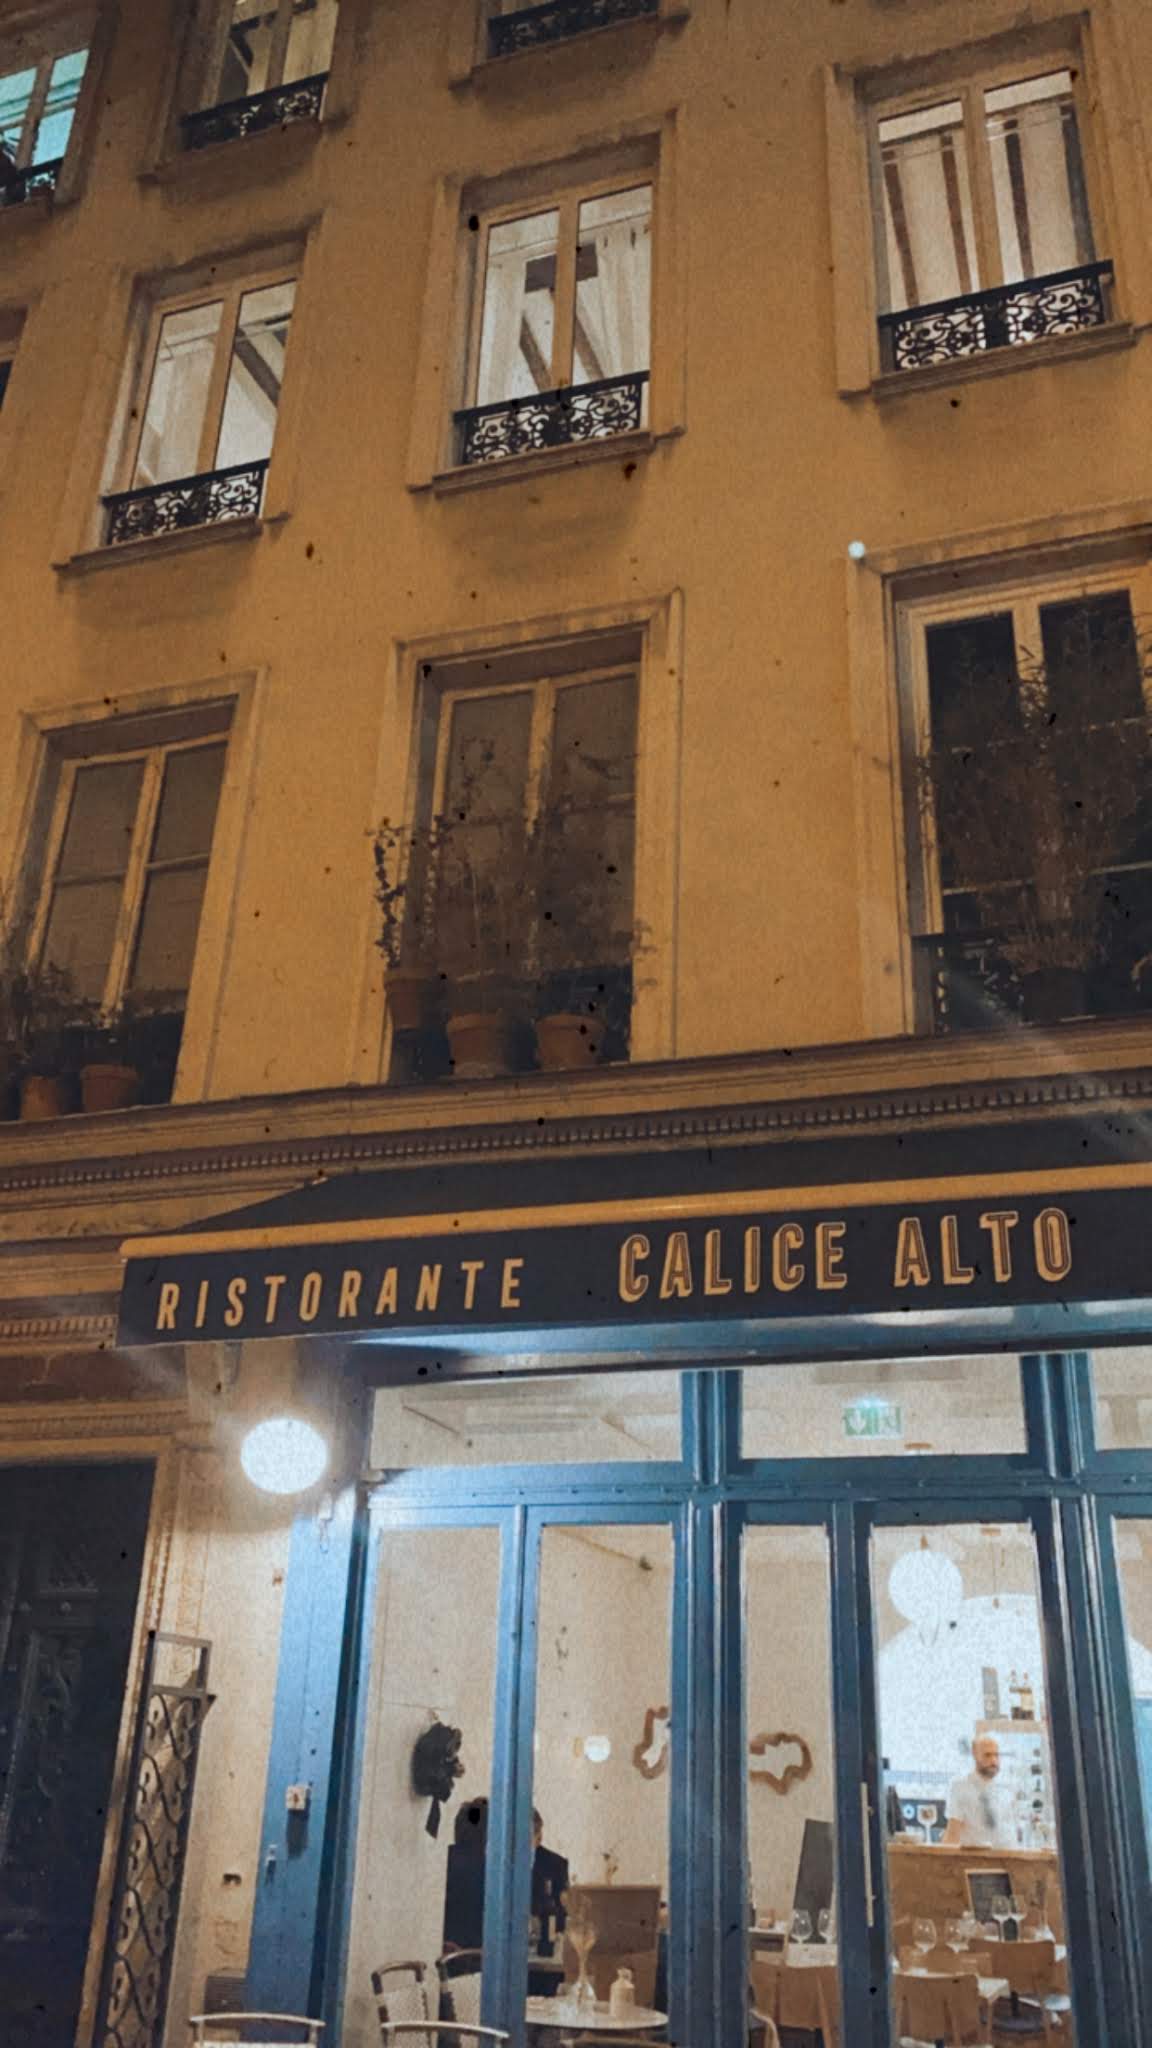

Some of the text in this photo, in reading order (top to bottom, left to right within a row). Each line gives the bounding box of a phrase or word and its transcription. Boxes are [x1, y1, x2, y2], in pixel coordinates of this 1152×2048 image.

[156, 1206, 1073, 1331] RISTORANTE CALICE ALTO
